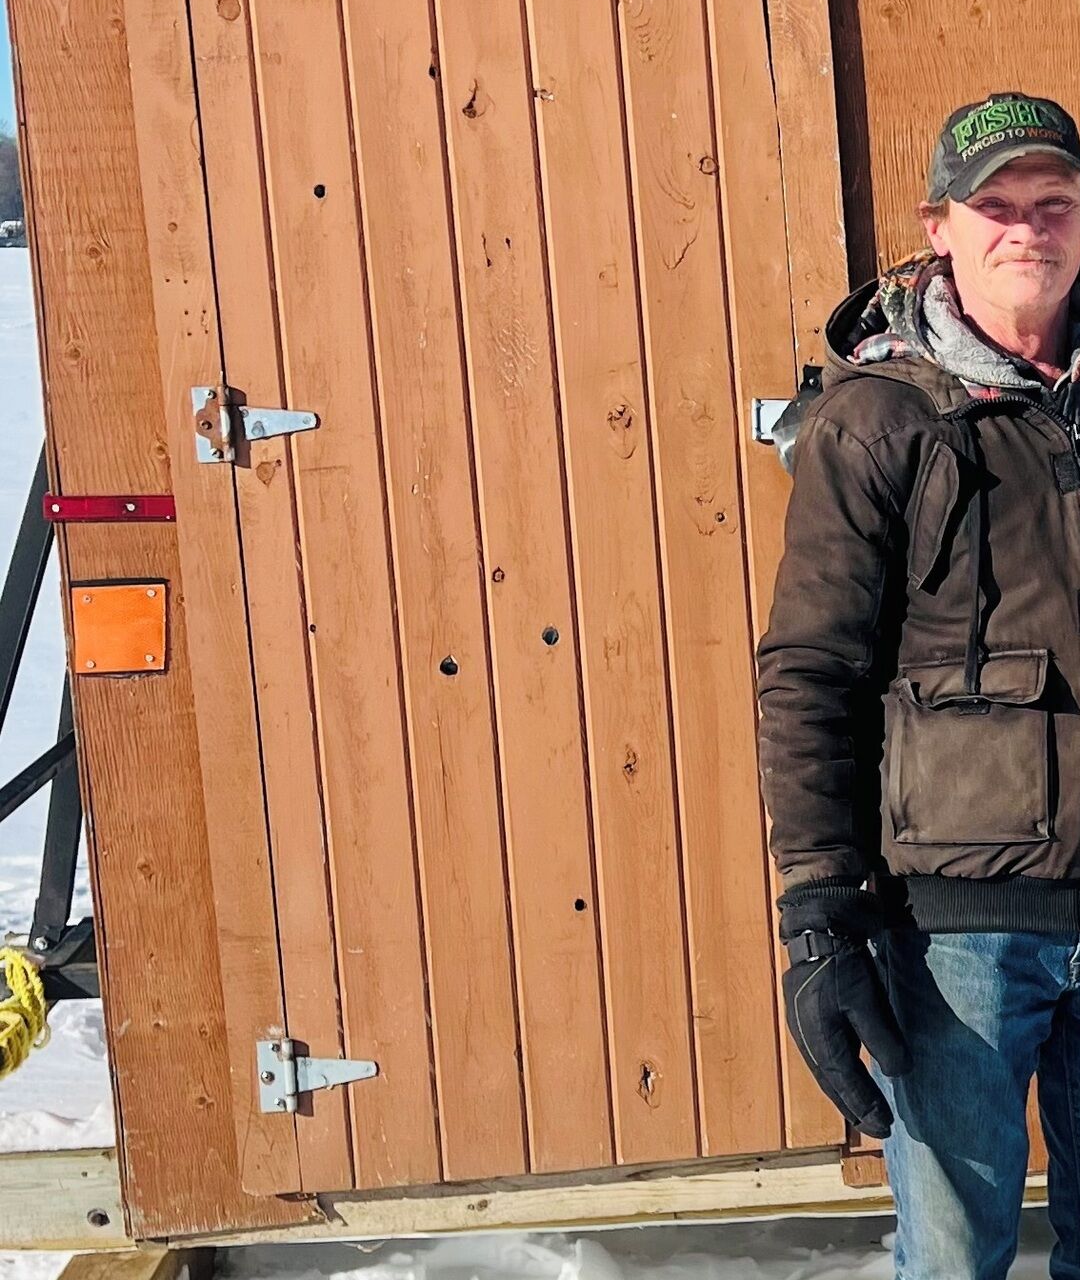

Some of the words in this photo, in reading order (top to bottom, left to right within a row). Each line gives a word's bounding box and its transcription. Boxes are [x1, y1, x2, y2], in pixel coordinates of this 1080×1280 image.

[951, 100, 1043, 154] FISH
[961, 132, 1005, 162] FORCED
[1006, 127, 1025, 139] TO
